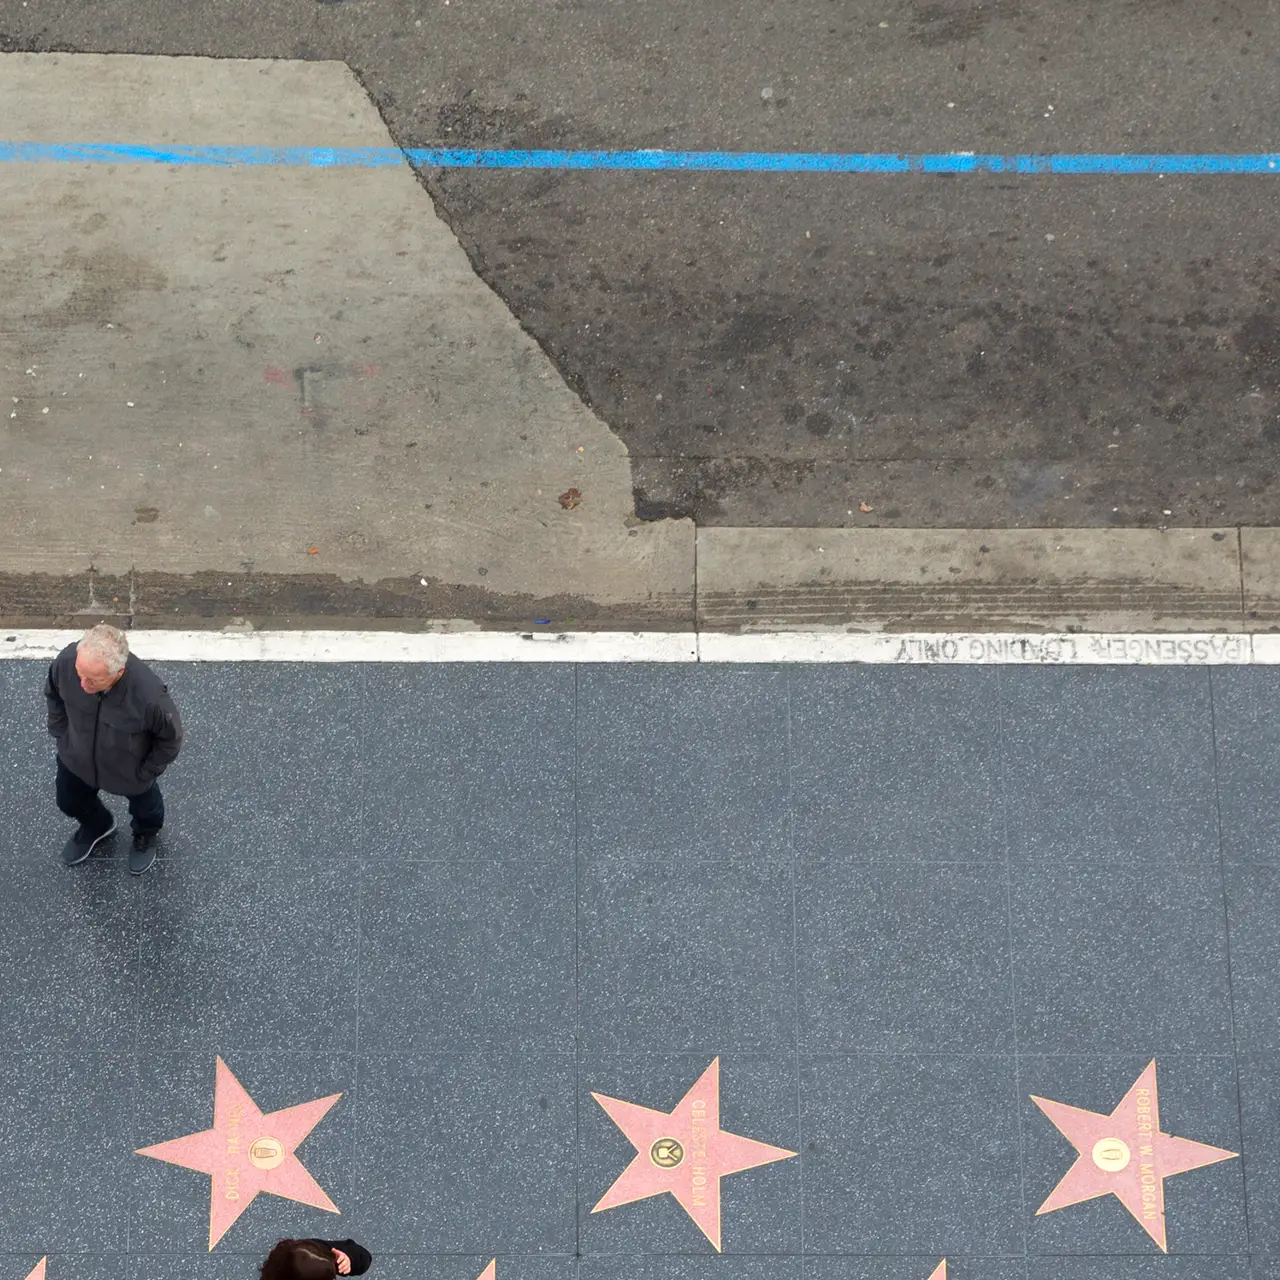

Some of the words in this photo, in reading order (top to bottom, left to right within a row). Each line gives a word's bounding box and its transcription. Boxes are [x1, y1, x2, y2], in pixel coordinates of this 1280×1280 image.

[894, 638, 959, 661] ONLY
[967, 638, 1078, 661] LOADING
[1091, 637, 1246, 661] PASSENGER
[692, 1099, 706, 1158] CELESTE
[1135, 1088, 1153, 1140] ROBERT
[225, 1168, 240, 1200] DICK
[692, 1168, 706, 1208] HOLM
[1140, 1163, 1157, 1220] MORGAN
